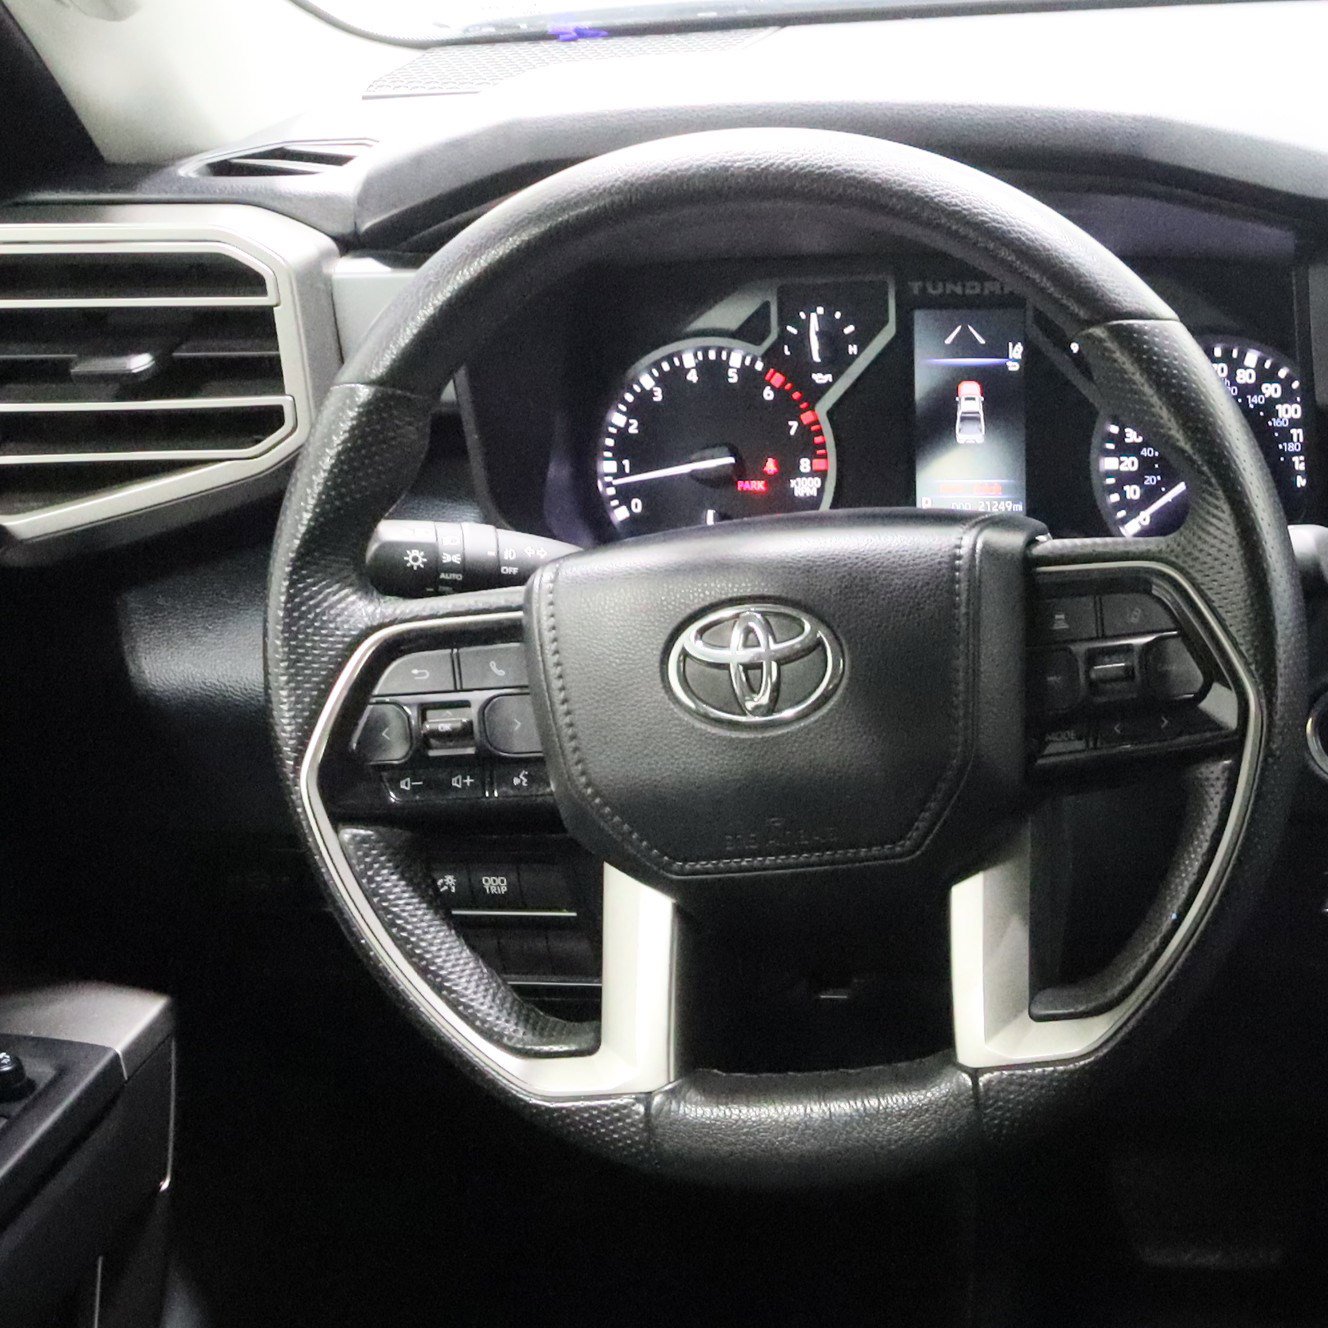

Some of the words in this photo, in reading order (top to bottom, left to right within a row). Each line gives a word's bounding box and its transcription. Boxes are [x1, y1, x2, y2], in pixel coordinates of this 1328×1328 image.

[686, 368, 699, 384] 4
[727, 368, 739, 383] 5
[1235, 368, 1257, 385] 80
[652, 387, 663, 402] 3
[762, 385, 775, 401] 6
[1260, 383, 1283, 399] 90
[1275, 403, 1302, 419] 100
[627, 419, 639, 434] 2
[788, 420, 800, 436] 7
[621, 458, 631, 474] 1
[799, 458, 811, 473] 8
[1119, 456, 1139, 471] 20
[737, 480, 766, 492] PARK
[794, 486, 818, 498] RPM
[1123, 484, 1140, 500] 10
[630, 497, 643, 513] 0
[440, 572, 463, 581] AUTO
[501, 566, 519, 575] OFF
[482, 876, 507, 886] ODO
[483, 885, 508, 895] TRIP
